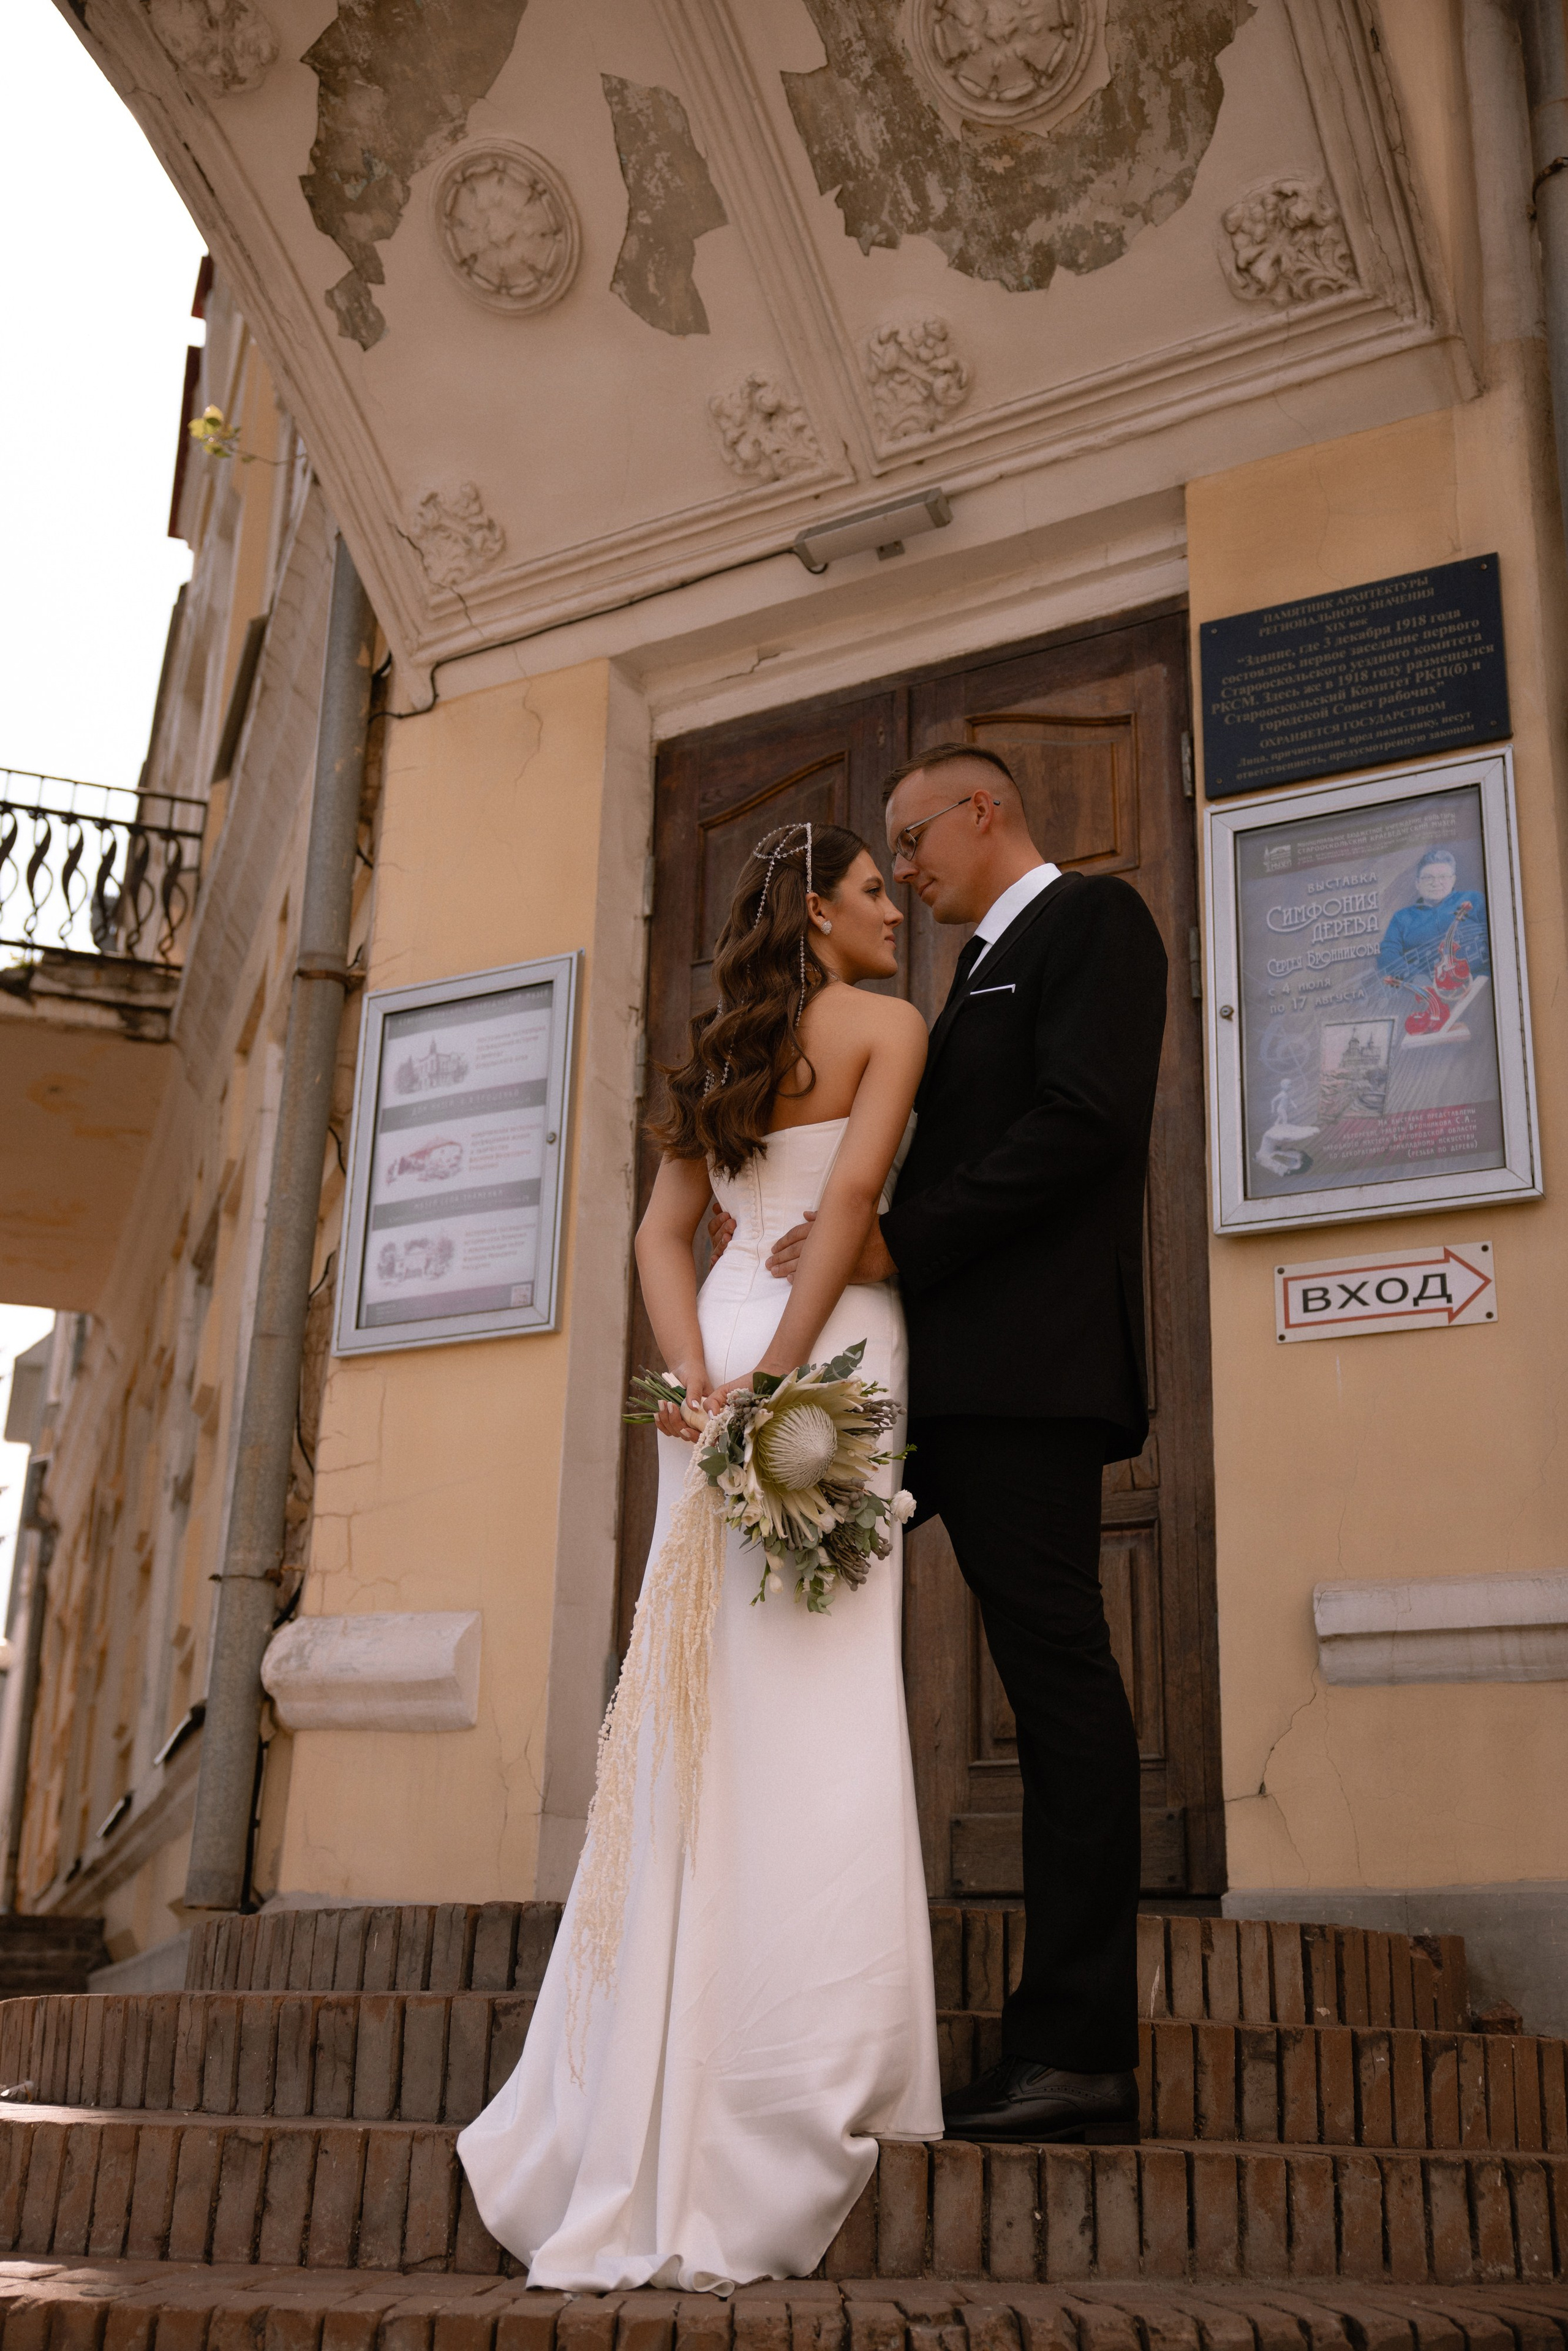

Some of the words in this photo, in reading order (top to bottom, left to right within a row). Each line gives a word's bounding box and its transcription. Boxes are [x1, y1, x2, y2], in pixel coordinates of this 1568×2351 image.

[1259, 605, 1366, 636] РЕГИОНАЛЬНОГО
[1371, 587, 1434, 610] ЗНАЧЕНИЯ
[1264, 599, 1333, 623] ПАМЯТНИК
[1337, 576, 1428, 605] АРХИТЕКТУРЫ
[1299, 642, 1320, 654] где
[1323, 636, 1331, 649] 3
[1335, 625, 1391, 647] декабря
[1396, 614, 1427, 632] 1918
[1430, 609, 1461, 624] года
[1349, 618, 1368, 628] век
[1221, 662, 1296, 685] состоялось
[1299, 650, 1346, 668] первое
[1352, 633, 1419, 655] заседание
[1423, 619, 1480, 639] первого
[1221, 664, 1346, 698] Старооскольского
[1350, 649, 1410, 673] уездного
[1414, 633, 1482, 655] комитета
[1212, 695, 1259, 715] РКСМ.
[1263, 689, 1300, 703] Здесь
[1304, 683, 1321, 694] же
[1325, 681, 1333, 689] в
[1338, 670, 1368, 686] 1918
[1373, 665, 1401, 679] году
[1406, 644, 1494, 674] размещался
[1224, 689, 1346, 725] Старооскольский
[1351, 677, 1409, 698] Комитет
[1415, 663, 1468, 683] РКП(б)
[1472, 662, 1480, 670] и
[1259, 723, 1340, 748] ОХРАНЯЕТСЯ
[1343, 701, 1446, 731] ГОСУДАРСТВОМ
[1260, 707, 1329, 731] городской
[1332, 699, 1374, 715] Совет
[1430, 725, 1474, 739] законом
[1281, 981, 1291, 994] 4
[1291, 994, 1308, 1009] 17
[1302, 1272, 1453, 1313] ВХОД
